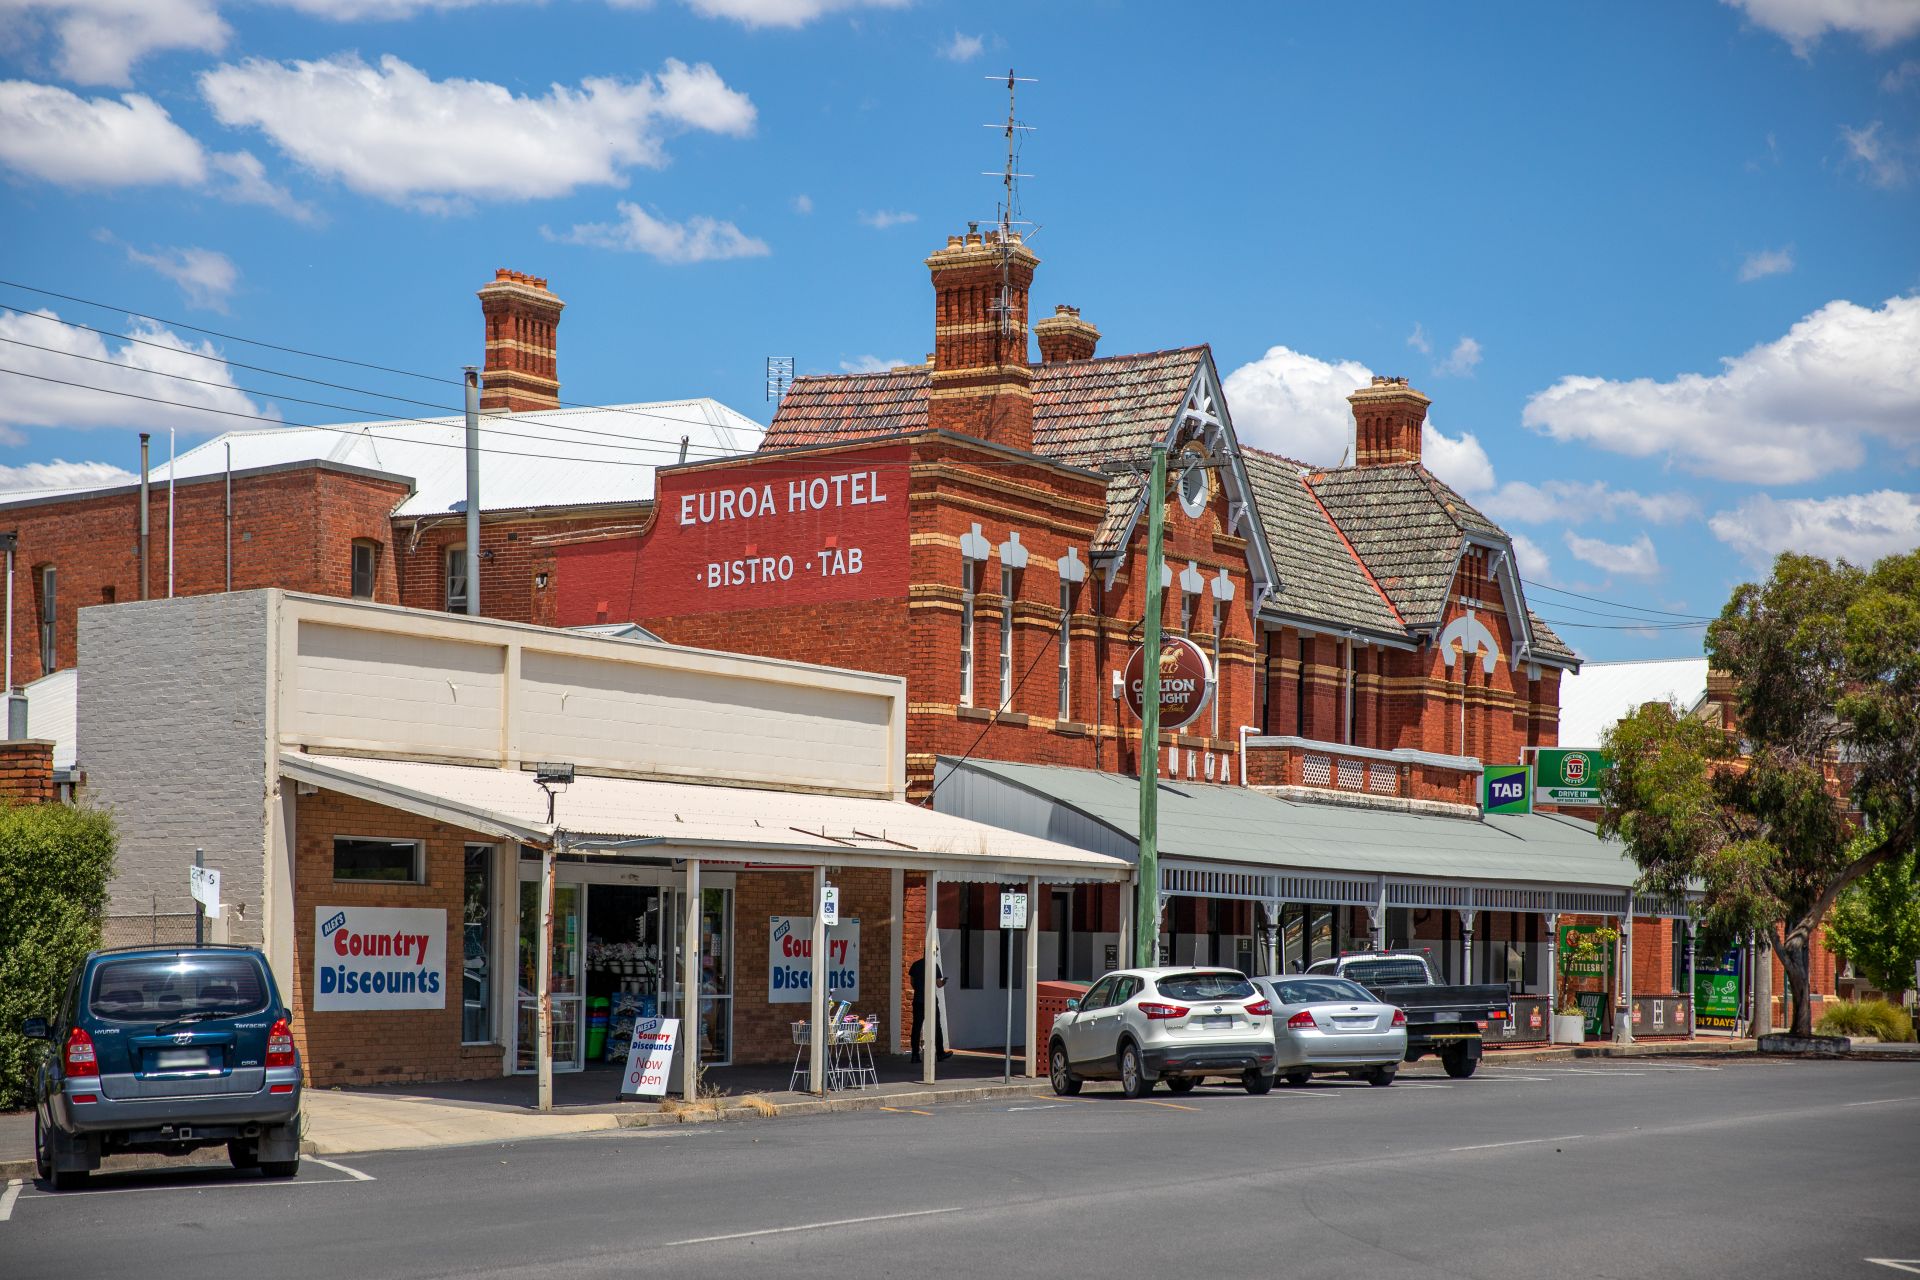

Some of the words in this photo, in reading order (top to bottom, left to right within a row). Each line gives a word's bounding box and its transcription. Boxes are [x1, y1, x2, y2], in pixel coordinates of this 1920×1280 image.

[680, 484, 776, 526] EUROA
[788, 471, 887, 512] HOTEL
[707, 555, 794, 588] BISTRO
[817, 548, 863, 577] TAB
[1132, 678, 1195, 692] CLTON
[1136, 692, 1191, 704] DUGHT
[1569, 764, 1583, 774] VB
[1491, 783, 1523, 798] TAB
[1558, 790, 1579, 798] DRIVE
[1004, 895, 1011, 904] P
[1015, 895, 1026, 904] 2P
[323, 913, 345, 935] ALEX'S
[334, 928, 430, 965] Country
[783, 934, 848, 965] Coury
[320, 964, 440, 994] Discounts
[773, 965, 855, 989] Discnts
[1581, 995, 1600, 1006] NOW
[1706, 1018, 1712, 1026] 7
[1713, 1018, 1735, 1027] DAYS
[638, 1032, 671, 1043] Country
[632, 1042, 673, 1051] Discounts
[635, 1056, 663, 1070] Now
[630, 1071, 662, 1087] Open
